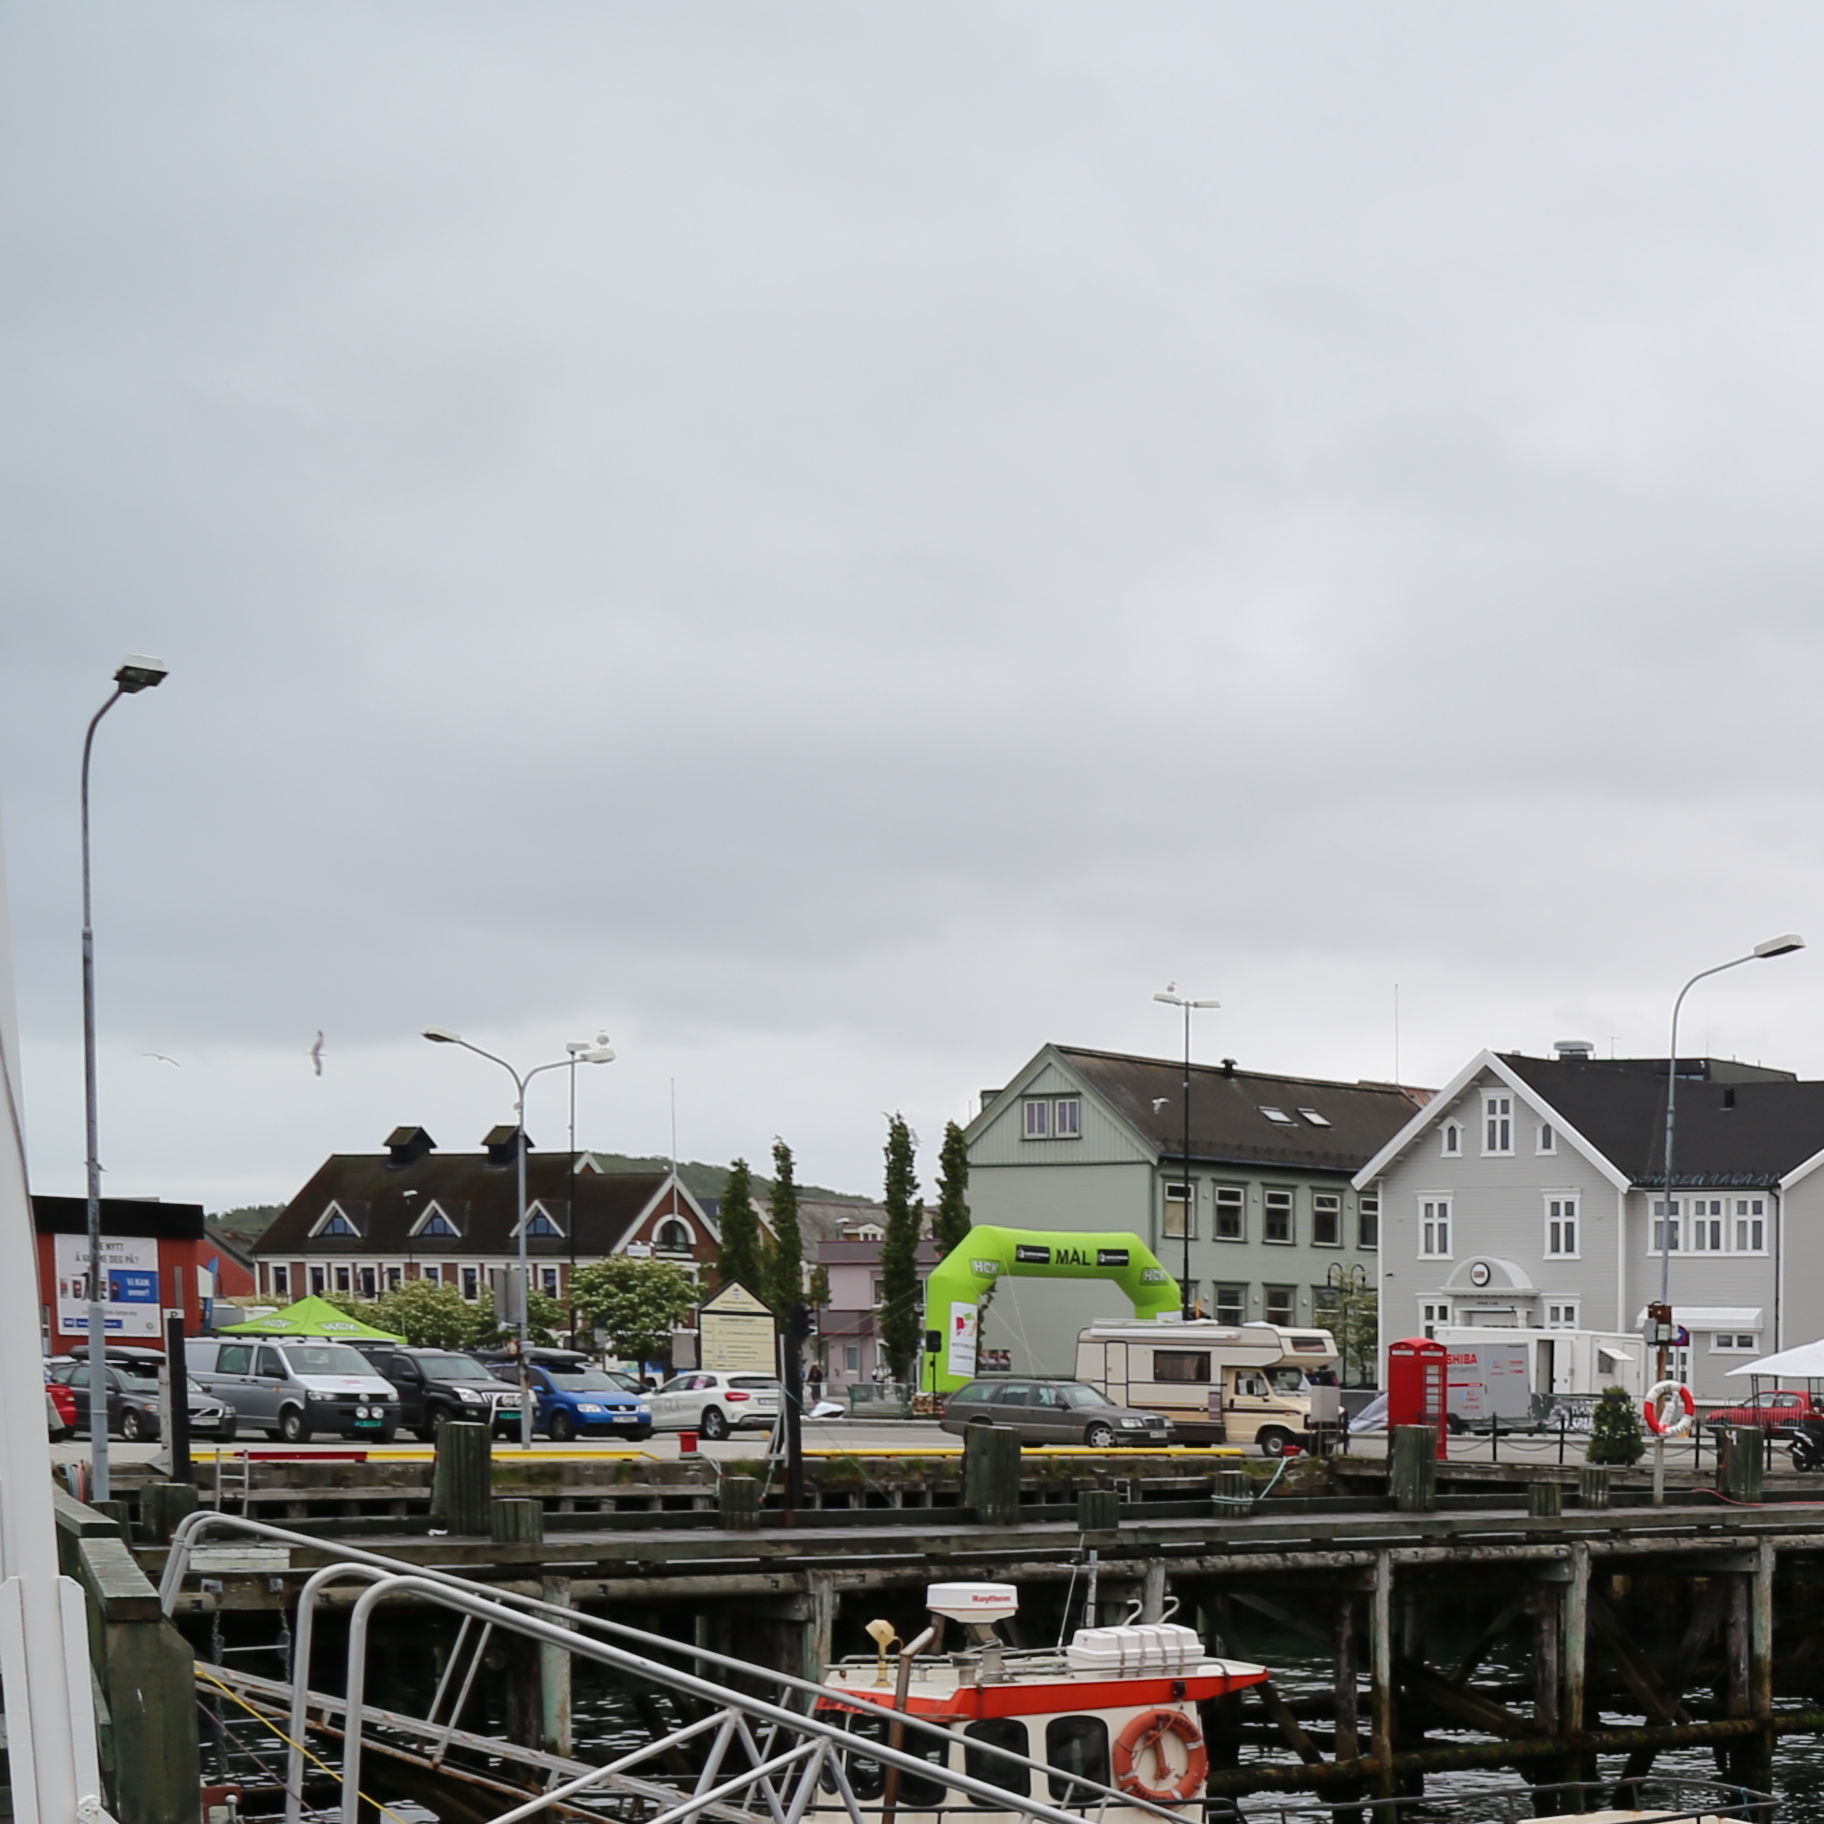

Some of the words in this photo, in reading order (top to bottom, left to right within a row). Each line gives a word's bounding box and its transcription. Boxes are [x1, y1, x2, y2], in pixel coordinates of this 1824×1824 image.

[1055, 1245, 1091, 1267] MÅL
[973, 1260, 999, 1275] HCK
[1143, 1268, 1165, 1282] HCK
[1447, 1354, 1478, 1365] SHIBA
